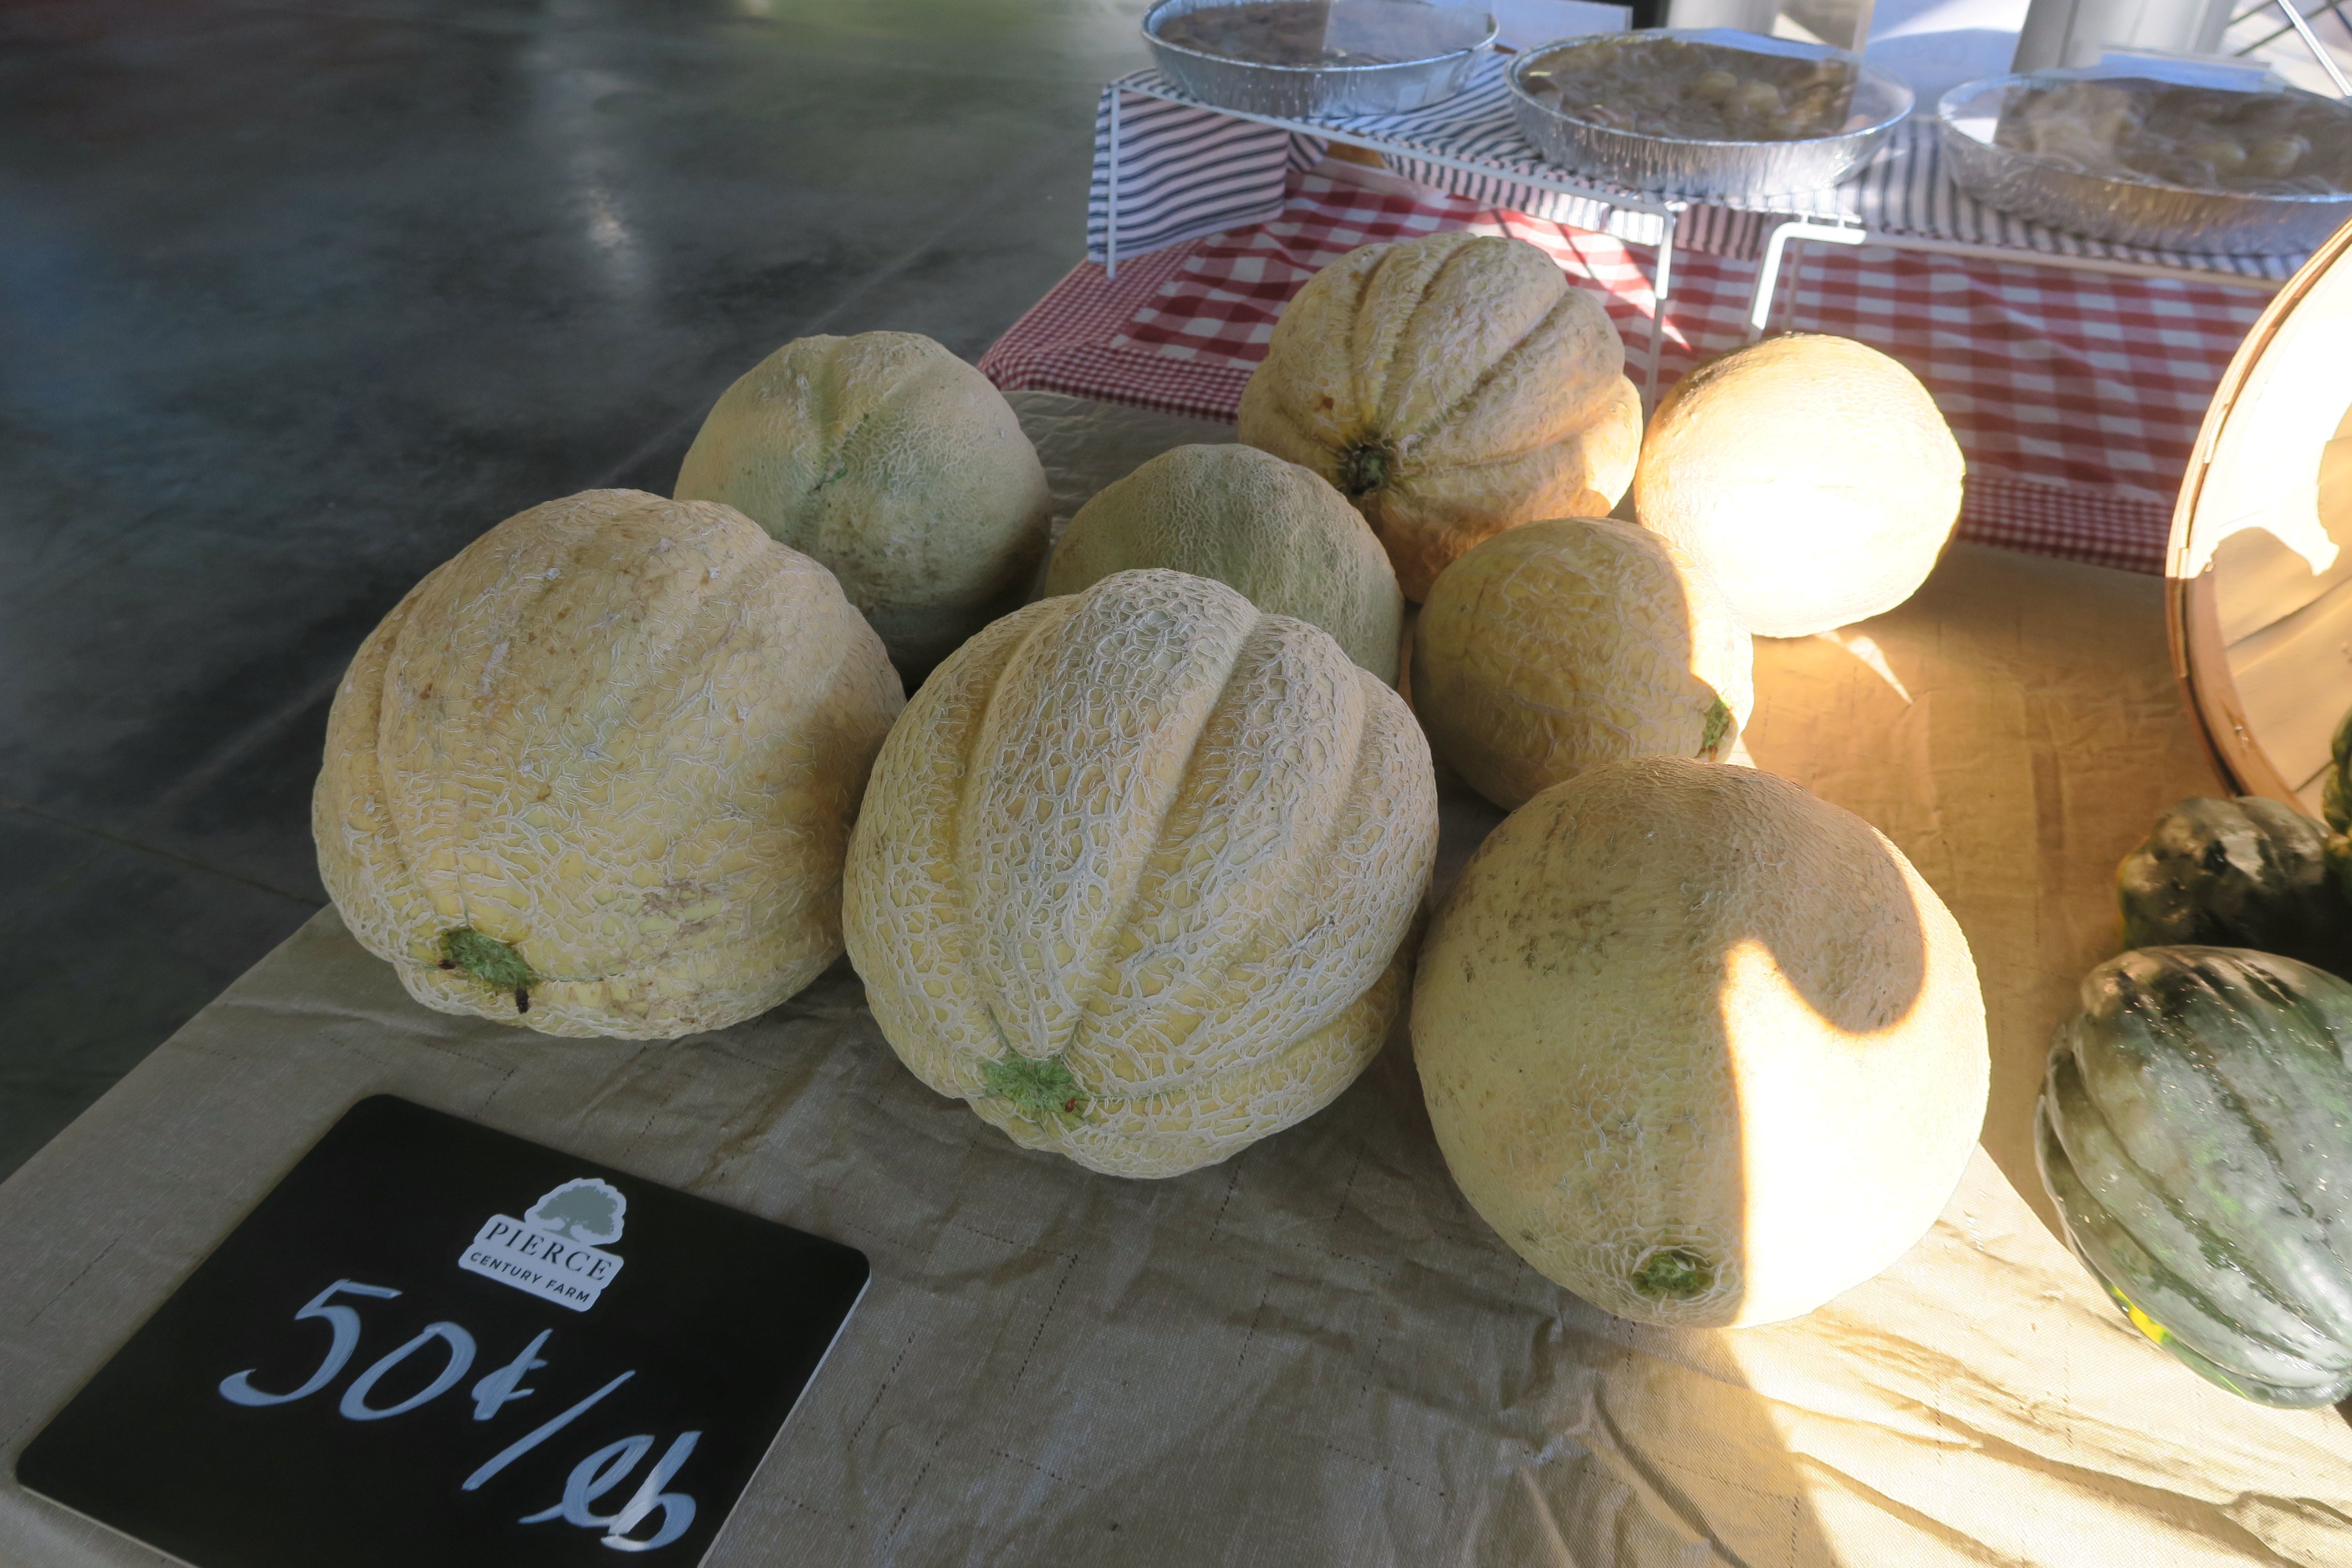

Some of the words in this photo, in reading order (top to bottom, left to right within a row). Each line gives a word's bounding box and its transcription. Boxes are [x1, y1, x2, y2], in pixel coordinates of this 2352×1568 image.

[471, 1252, 542, 1283] CENTURY
[546, 1280, 590, 1302] FARM
[485, 1222, 612, 1281] PIERCE
